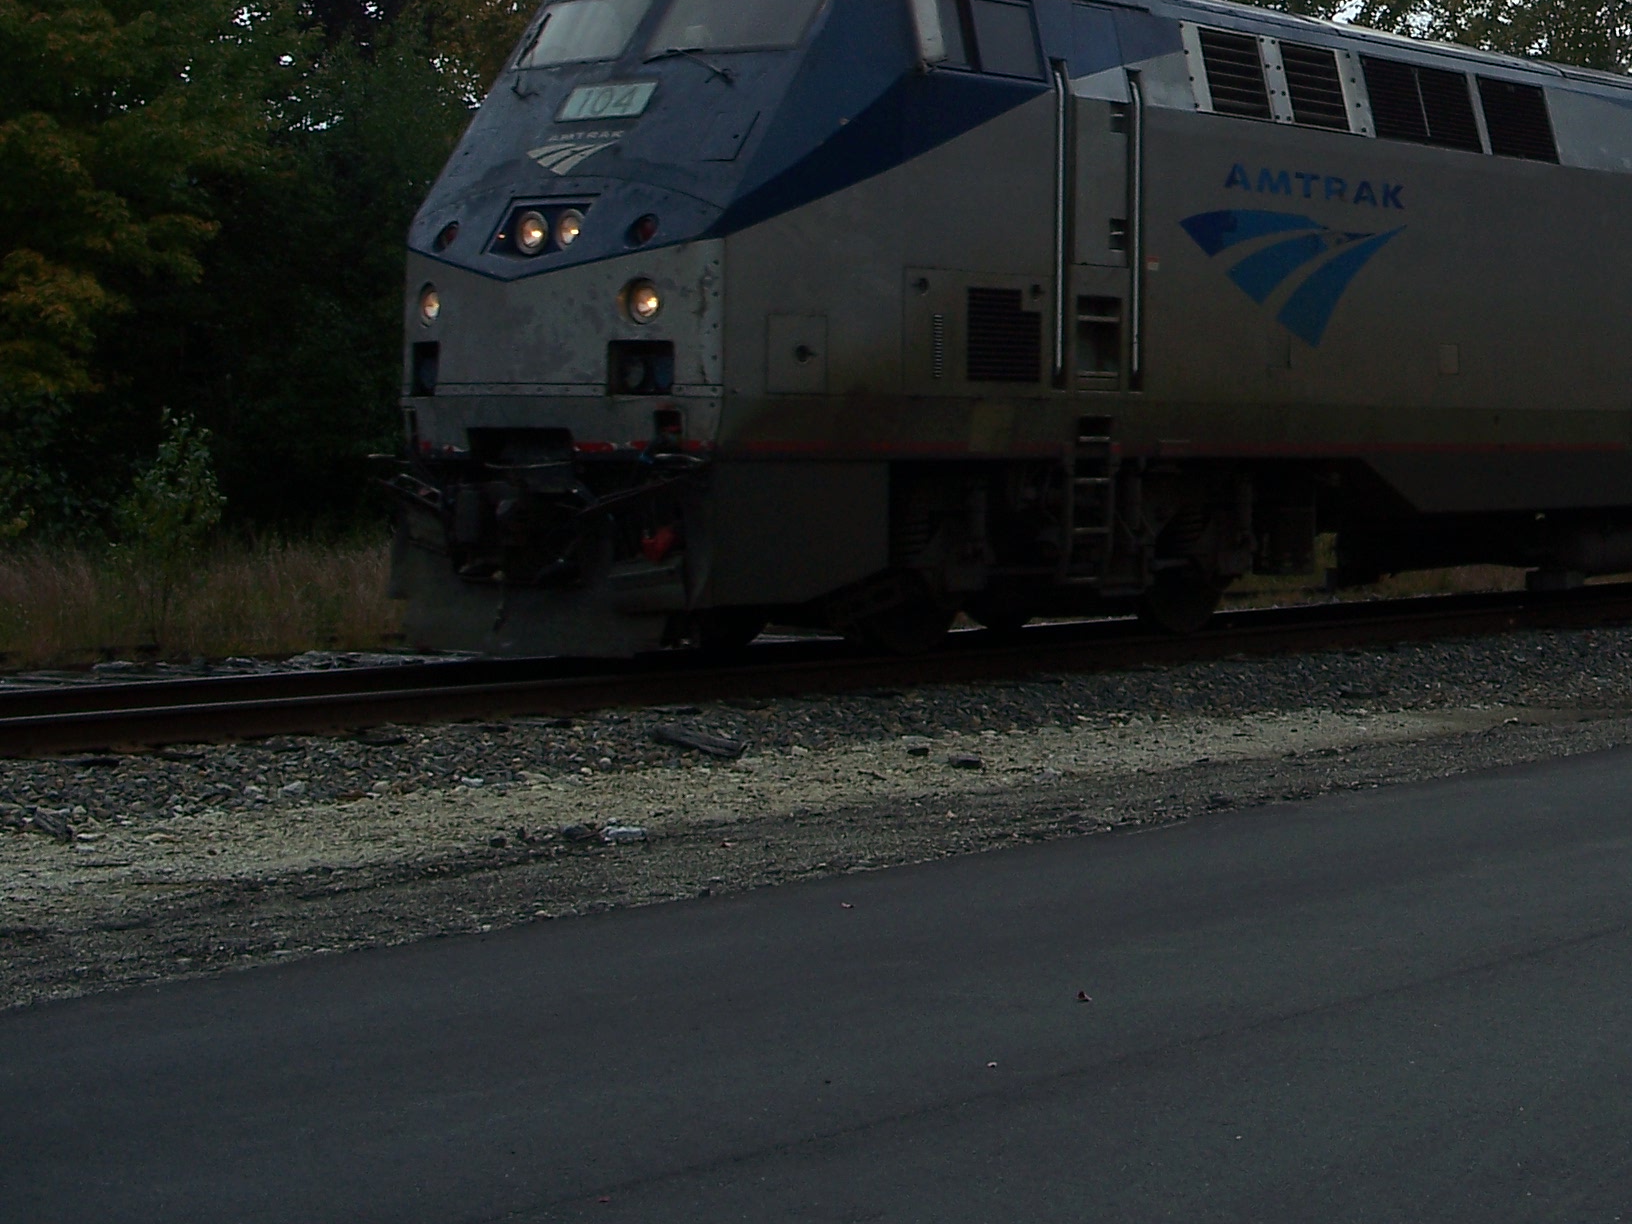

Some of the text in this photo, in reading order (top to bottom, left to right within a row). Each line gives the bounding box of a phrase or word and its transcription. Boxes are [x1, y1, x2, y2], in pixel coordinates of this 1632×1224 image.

[577, 86, 639, 116] 104
[548, 130, 625, 142] AMTRAK
[1224, 163, 1405, 209] AMTRAK
